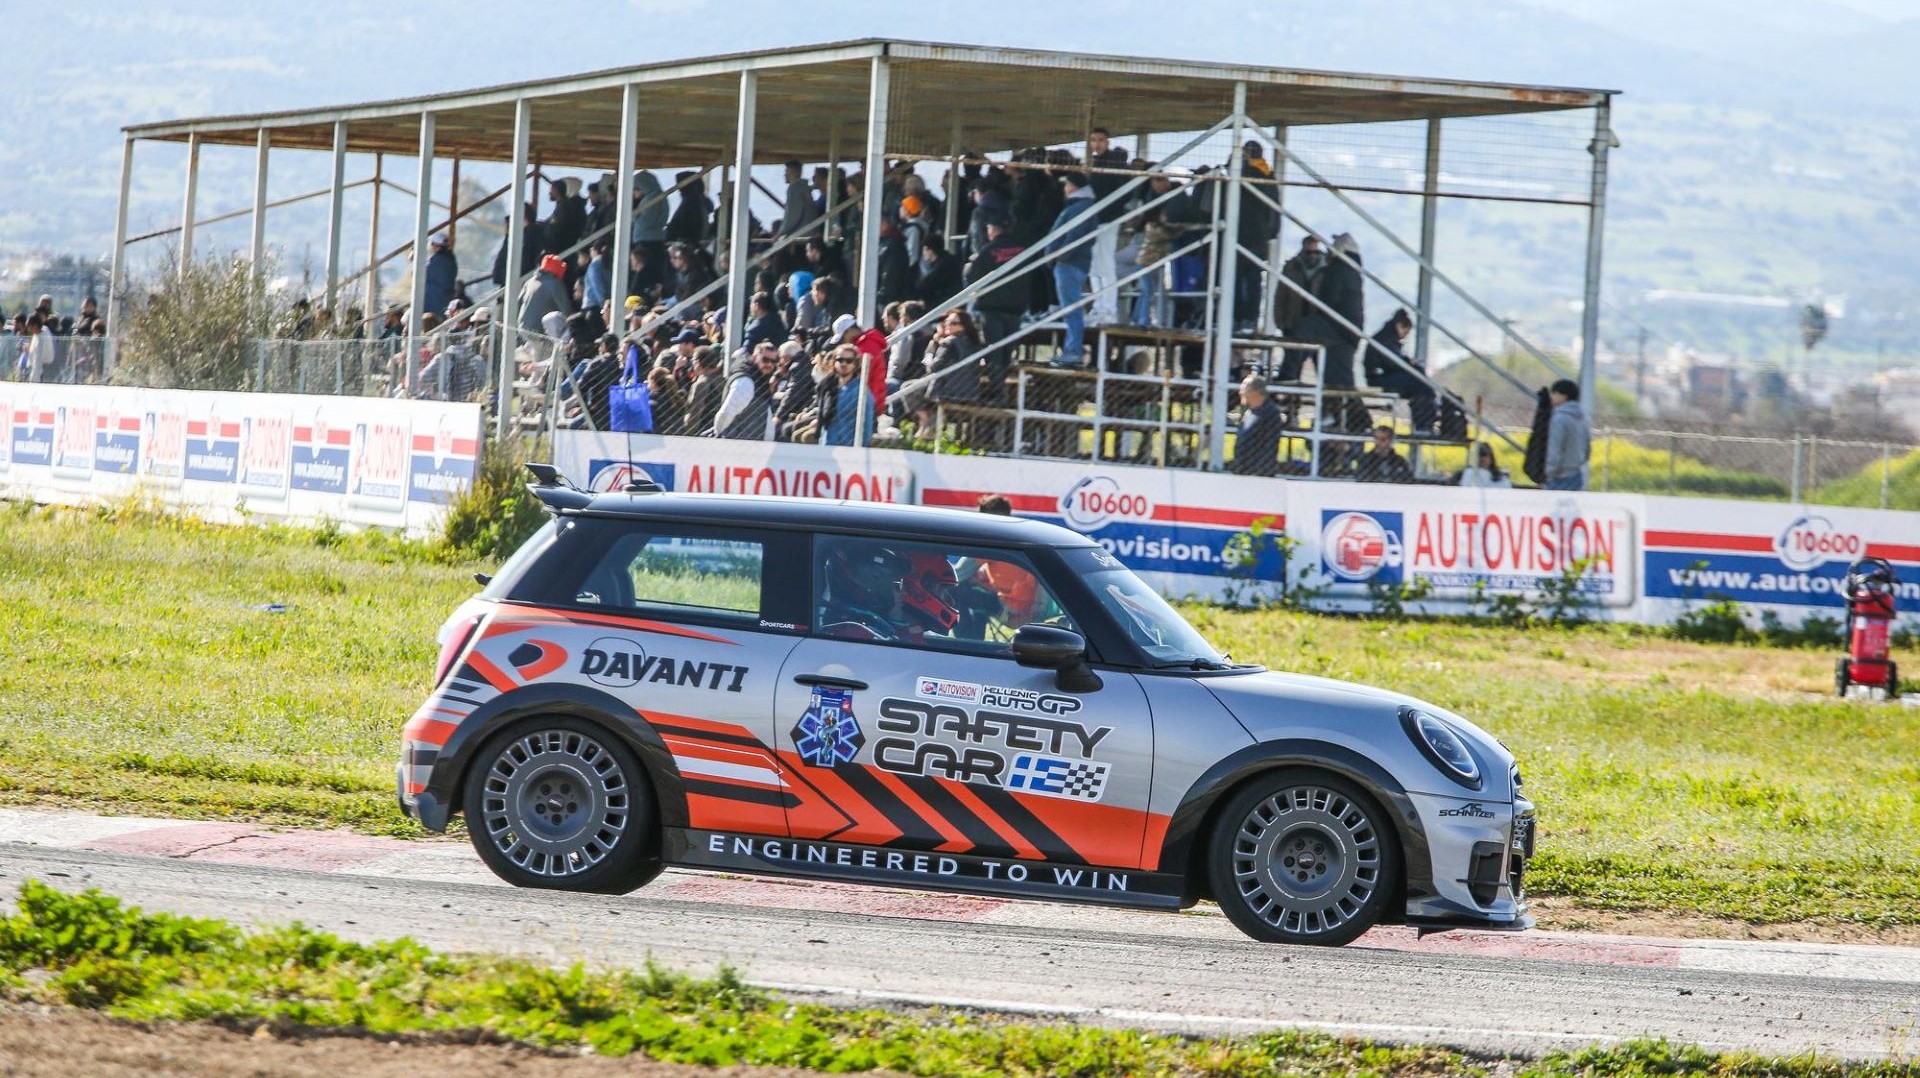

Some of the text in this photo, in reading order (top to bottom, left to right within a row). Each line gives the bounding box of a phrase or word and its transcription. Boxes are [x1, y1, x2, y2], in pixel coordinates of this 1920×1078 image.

[1079, 491, 1147, 516] 10600
[1414, 512, 1615, 572] AUTOVISION
[1794, 530, 1860, 555] 10600
[579, 648, 749, 692] DAVANTI
[938, 683, 977, 697] AUTOVISION
[983, 686, 1038, 700] HELLENIC
[877, 698, 1112, 758] SAFETY
[873, 738, 1006, 786] CAR
[1438, 809, 1496, 819] SCHNITZER
[708, 834, 1129, 892] ENGINEERED TO WIN
